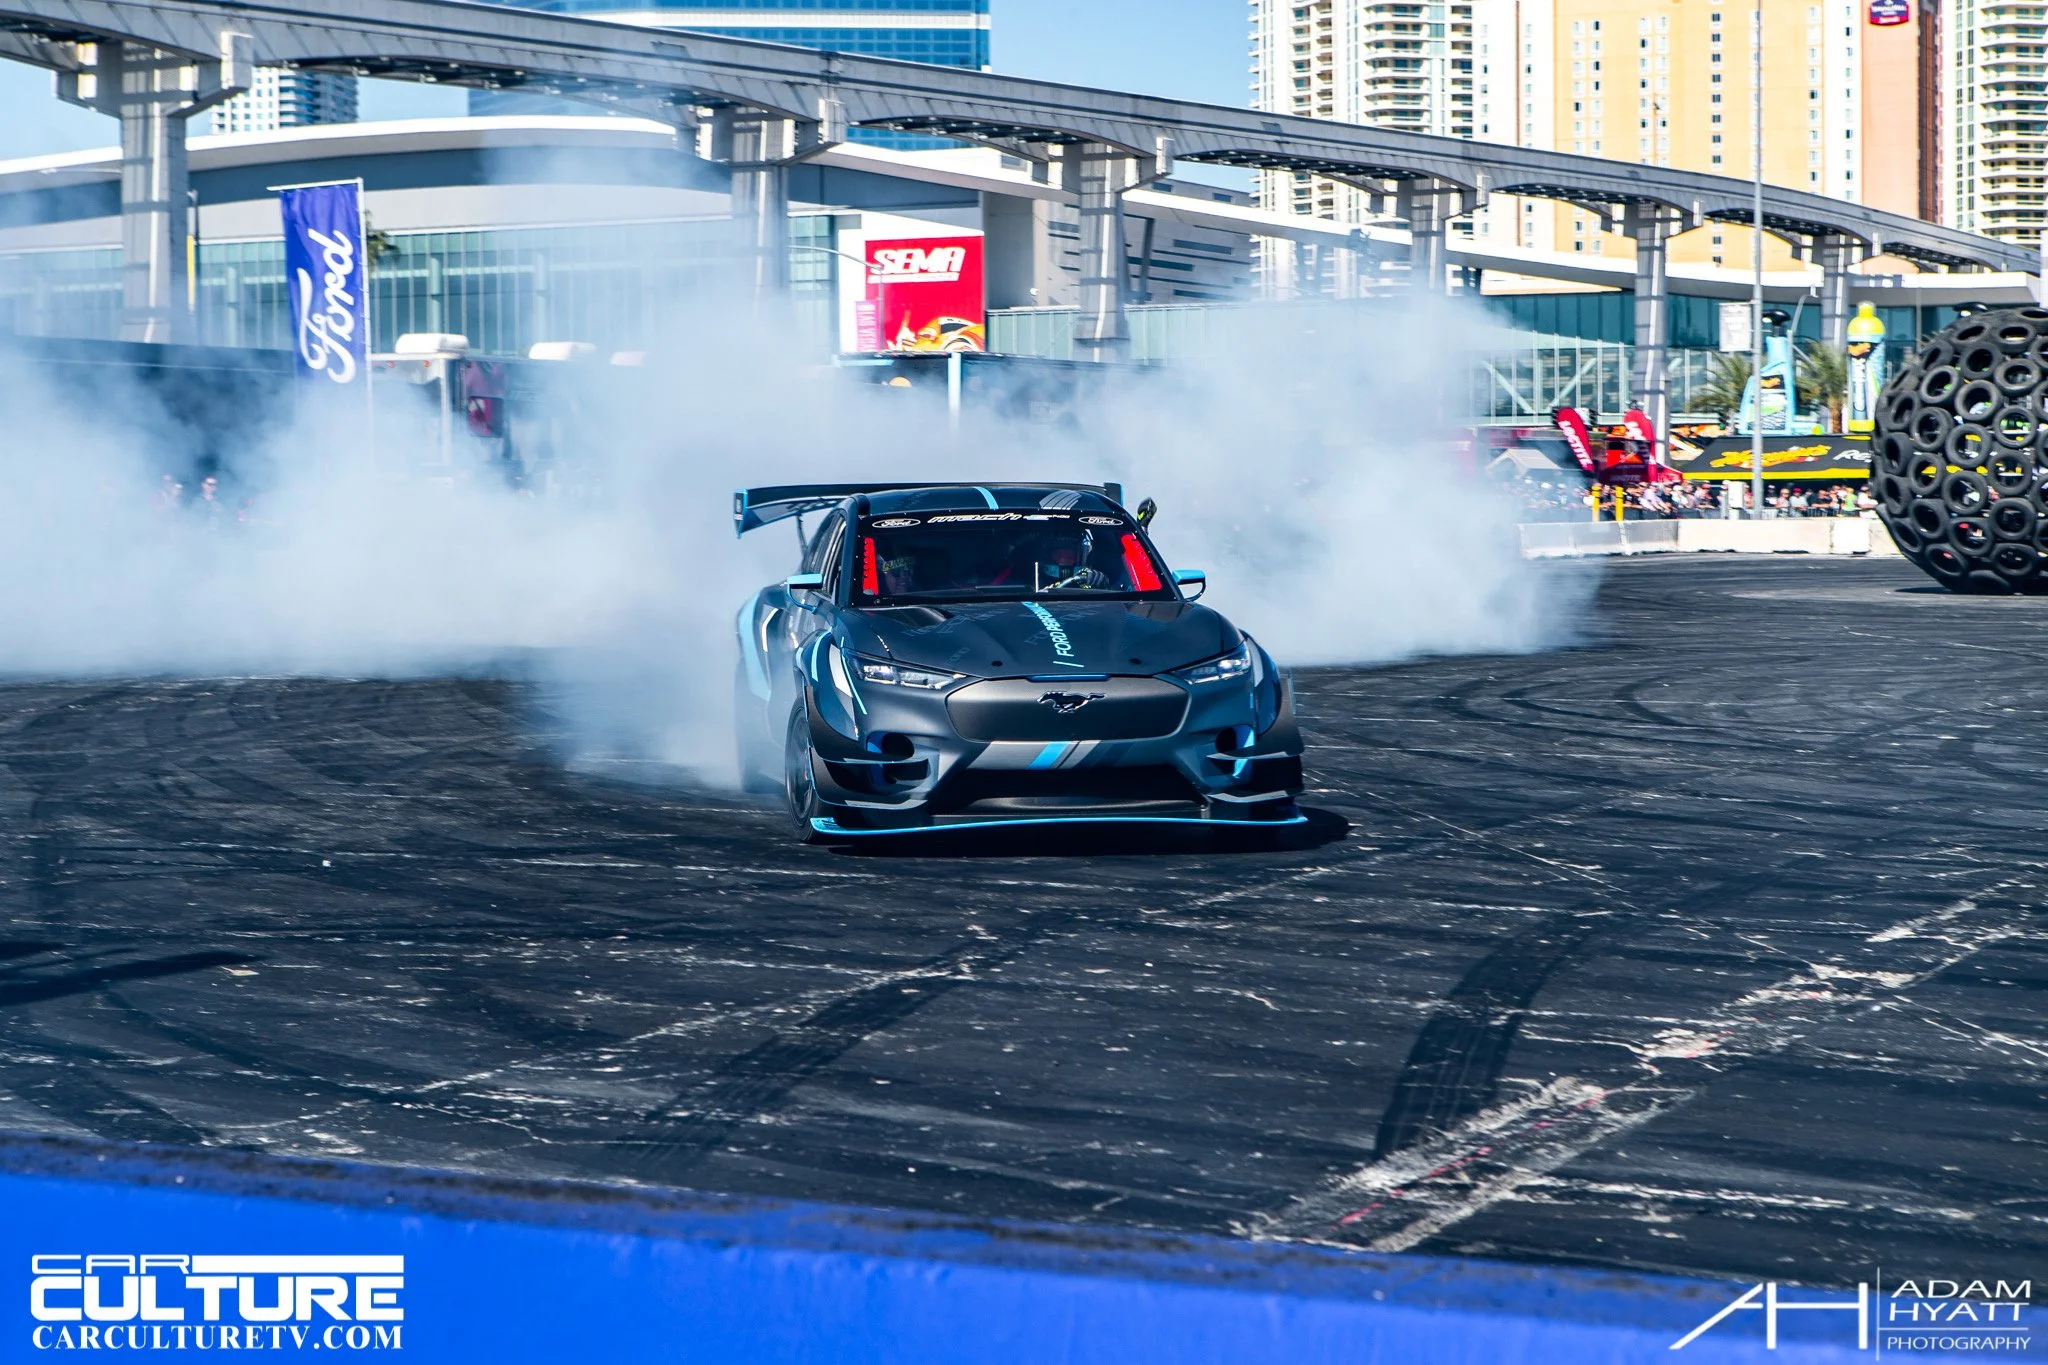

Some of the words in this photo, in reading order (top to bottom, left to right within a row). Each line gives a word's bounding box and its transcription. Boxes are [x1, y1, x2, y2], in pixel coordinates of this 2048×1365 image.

[870, 247, 966, 274] SEMA
[297, 228, 356, 383] Ford
[1558, 420, 1593, 468] LOCTITE
[1050, 631, 1074, 657] FORD
